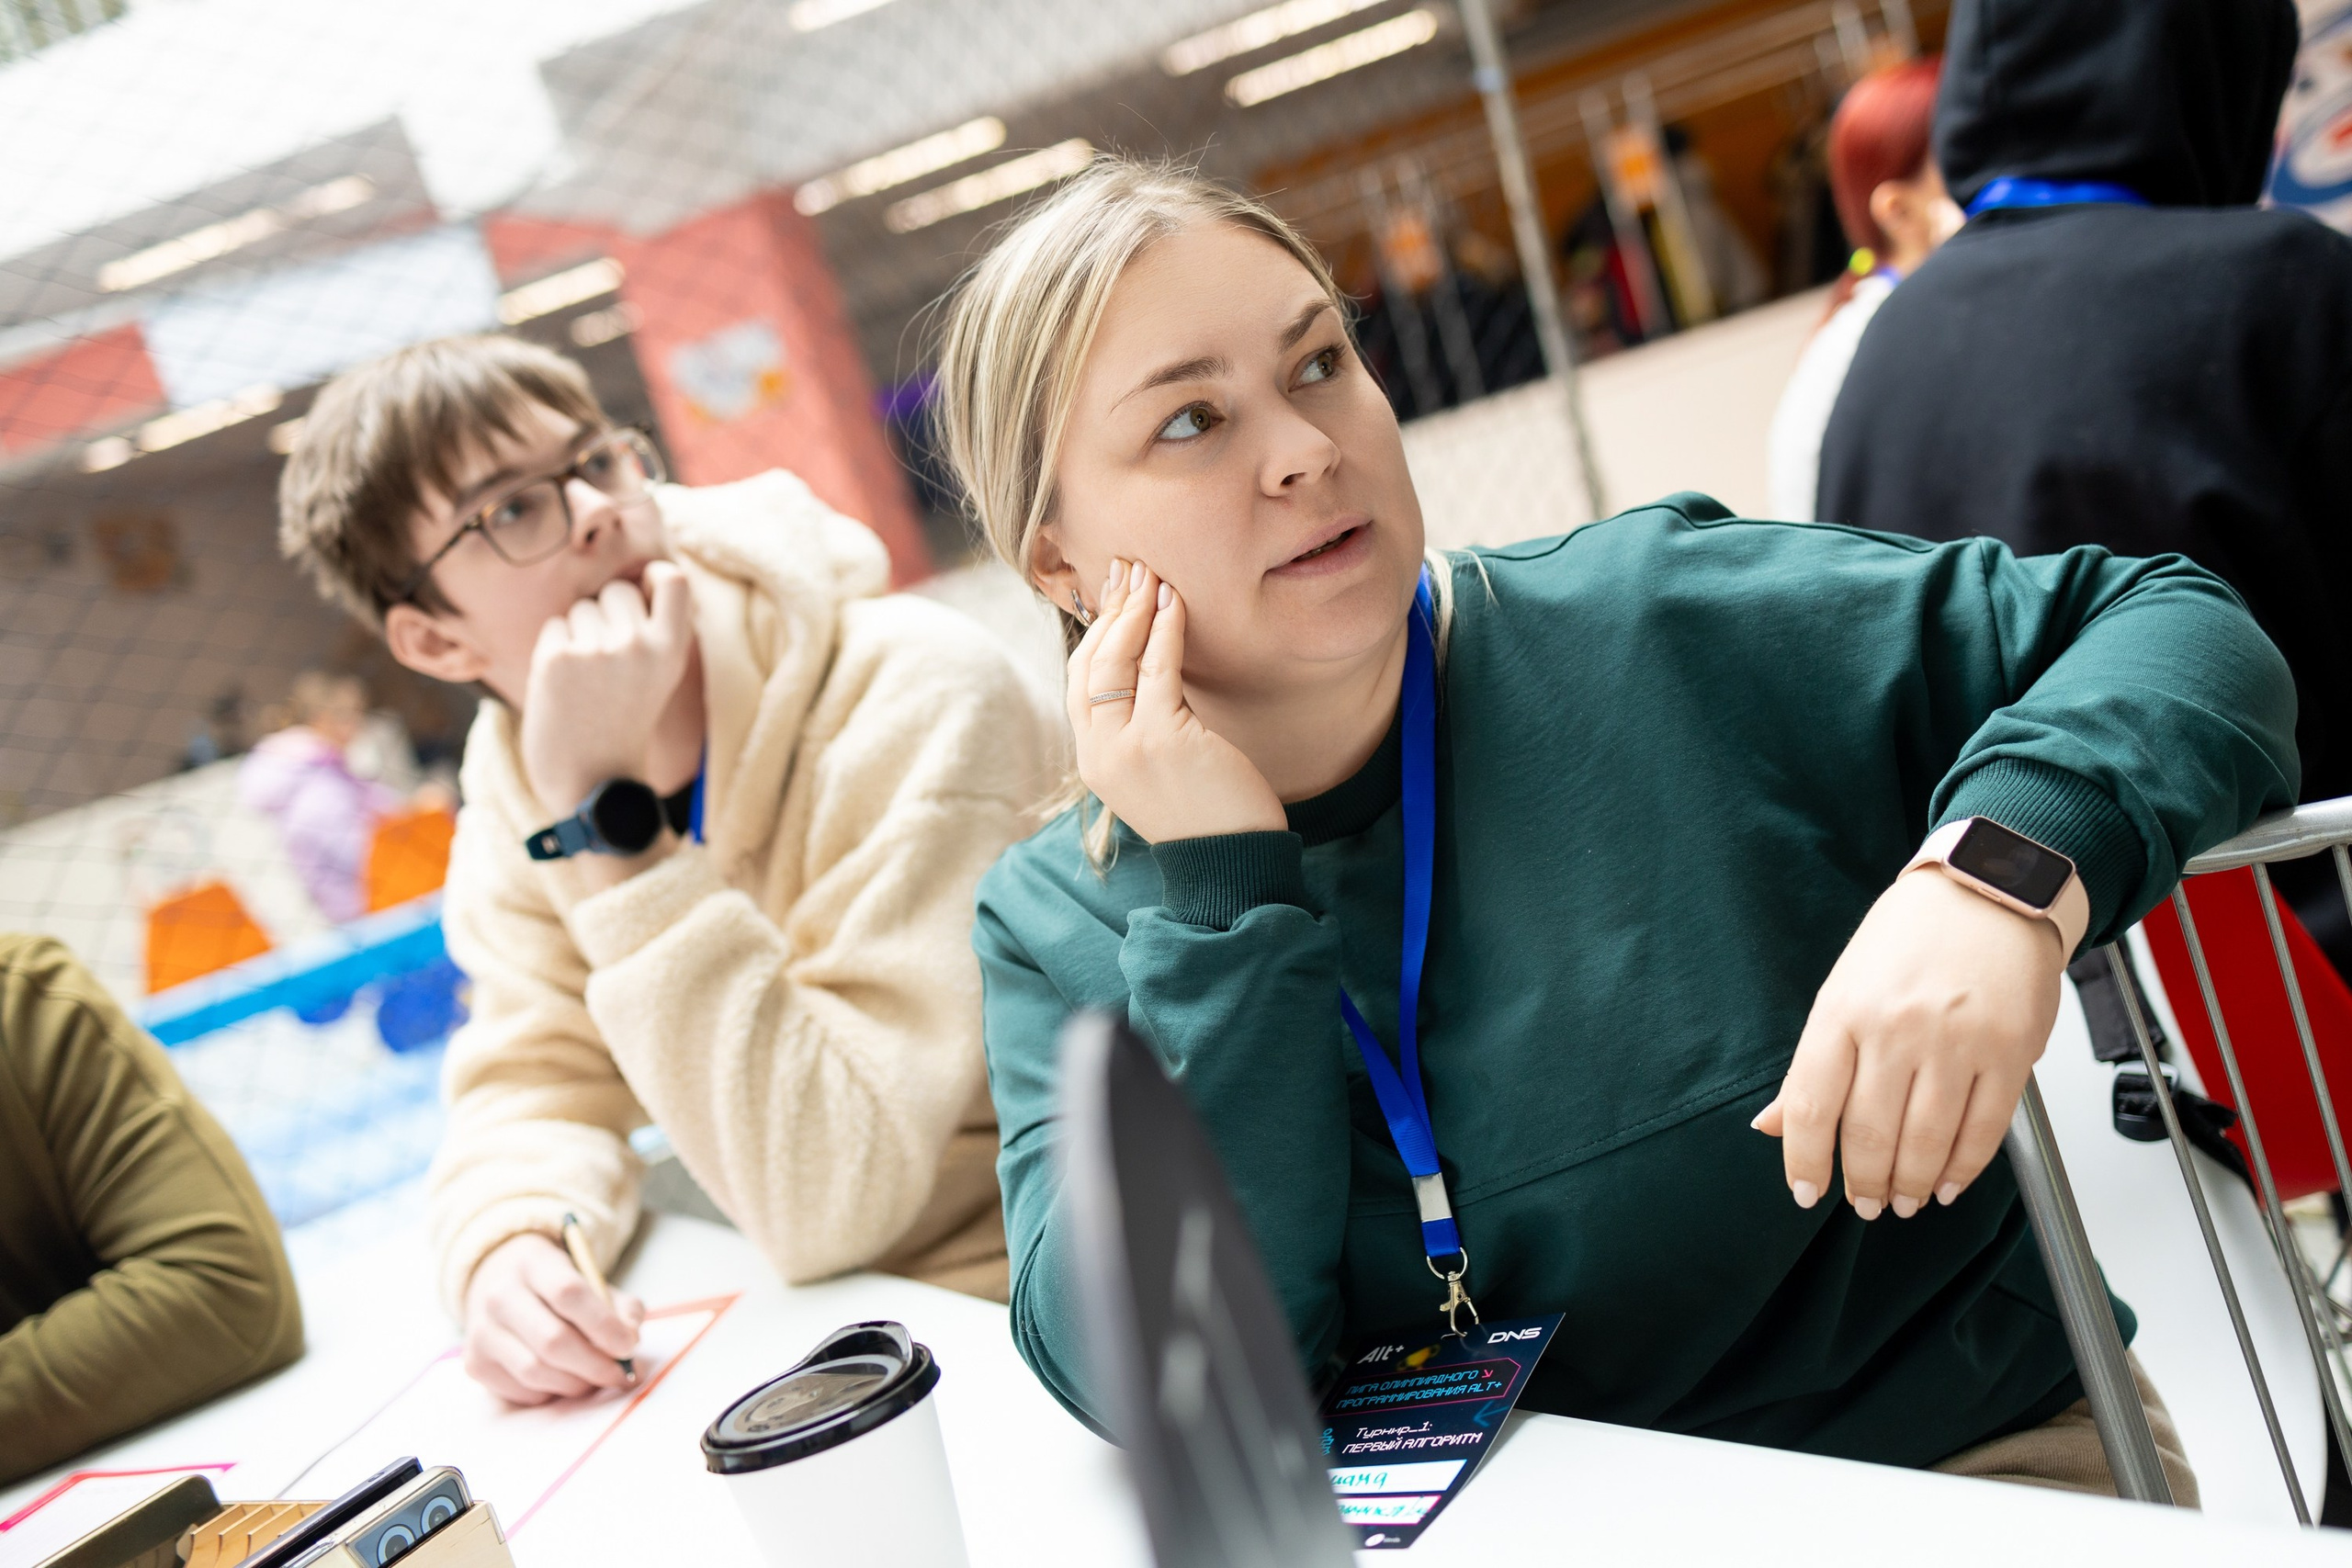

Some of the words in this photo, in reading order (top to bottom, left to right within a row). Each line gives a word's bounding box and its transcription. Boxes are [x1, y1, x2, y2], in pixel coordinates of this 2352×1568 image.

[1487, 1326, 1543, 1344] DNS
[1357, 1345, 1405, 1364] Alt+
[1345, 1382, 1380, 1395] ЛИГА
[1380, 1370, 1479, 1391] ОЛИМПИАДНОГО
[1336, 1384, 1466, 1409] ПРОГРАММИРОВАНИЯ
[1341, 1436, 1404, 1454] ПЕРВЫЙ
[1401, 1432, 1484, 1450] АЛГОРИТМ
